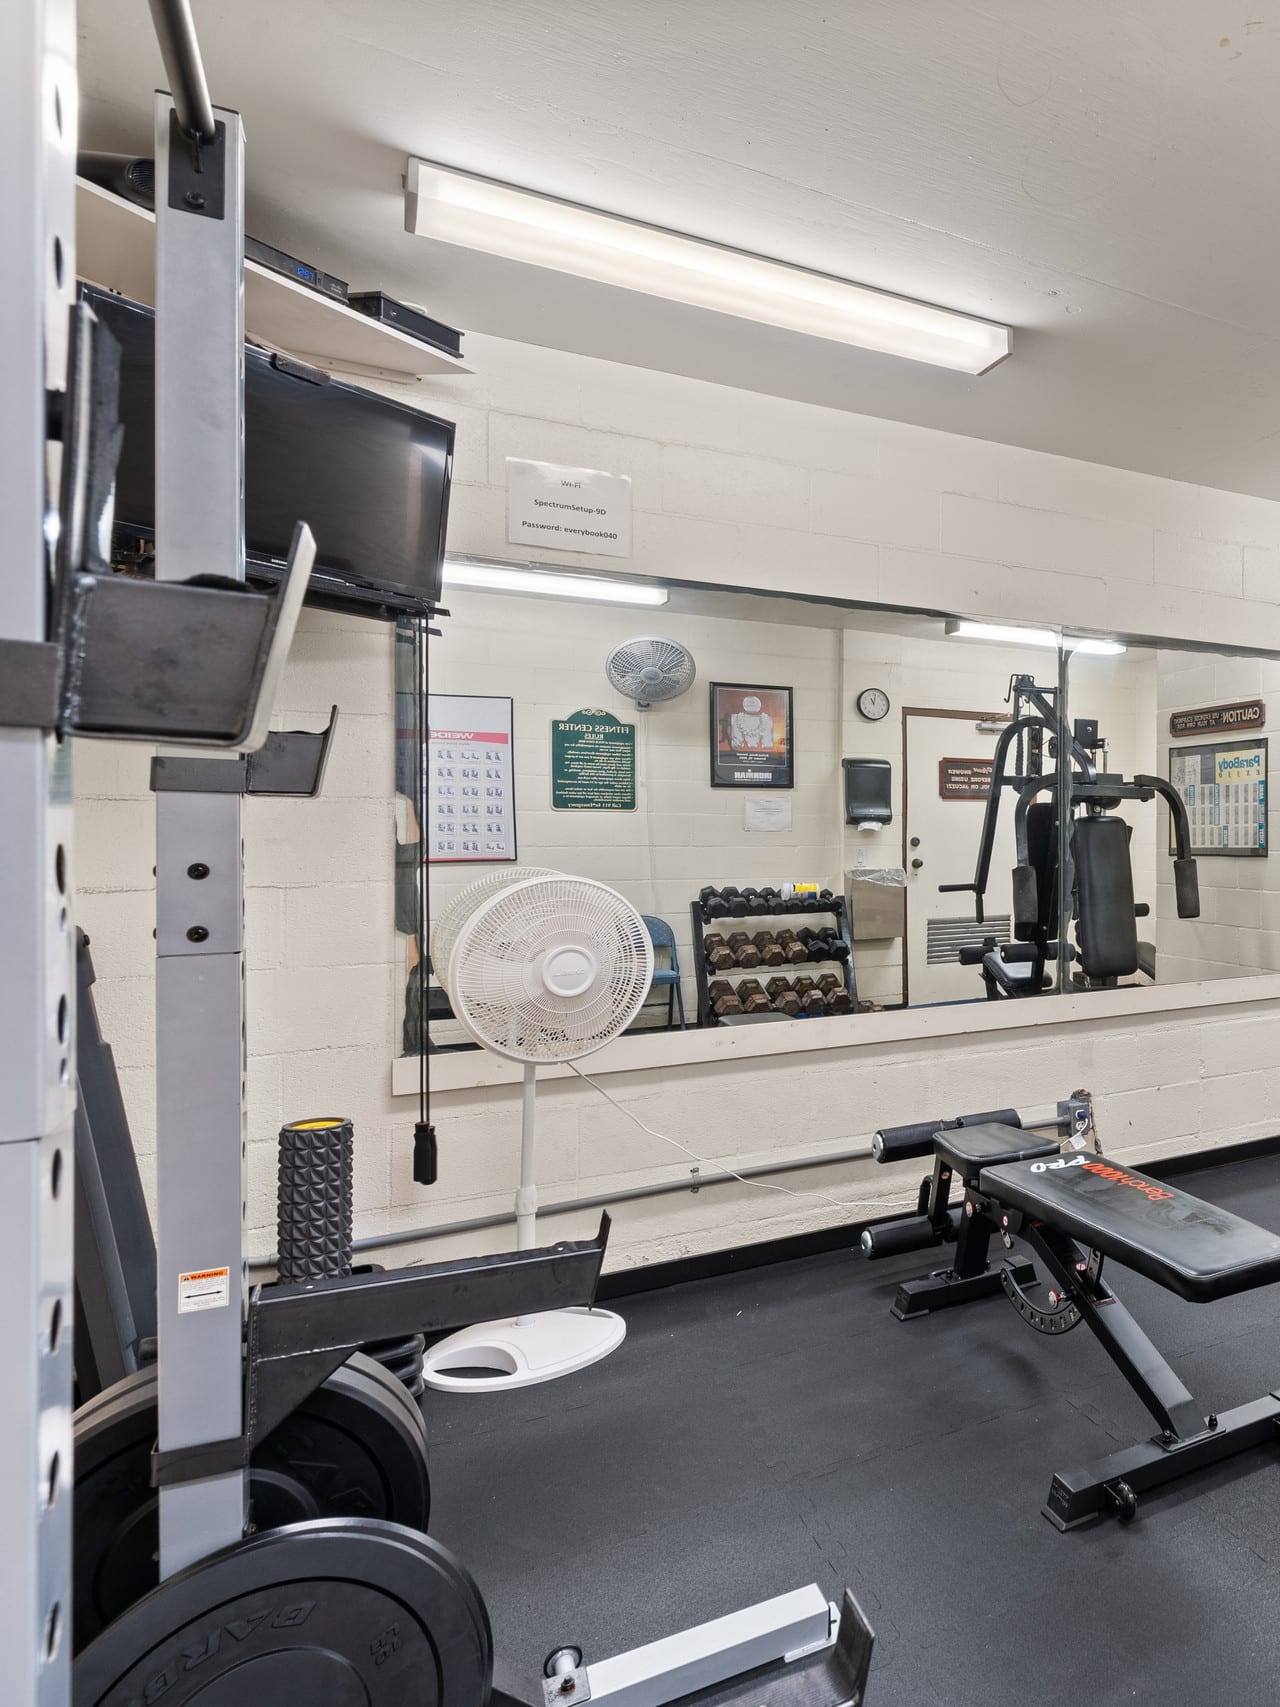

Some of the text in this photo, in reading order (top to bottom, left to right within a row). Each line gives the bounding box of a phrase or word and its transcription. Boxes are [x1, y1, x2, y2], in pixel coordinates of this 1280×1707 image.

[560, 479, 582, 489] Wi-Fi
[534, 499, 607, 516] SpectrumSetup-9D
[522, 520, 618, 540] Password: everybook040
[1030, 1155, 1091, 1173] PRO
[190, 1271, 224, 1280] WARNING
